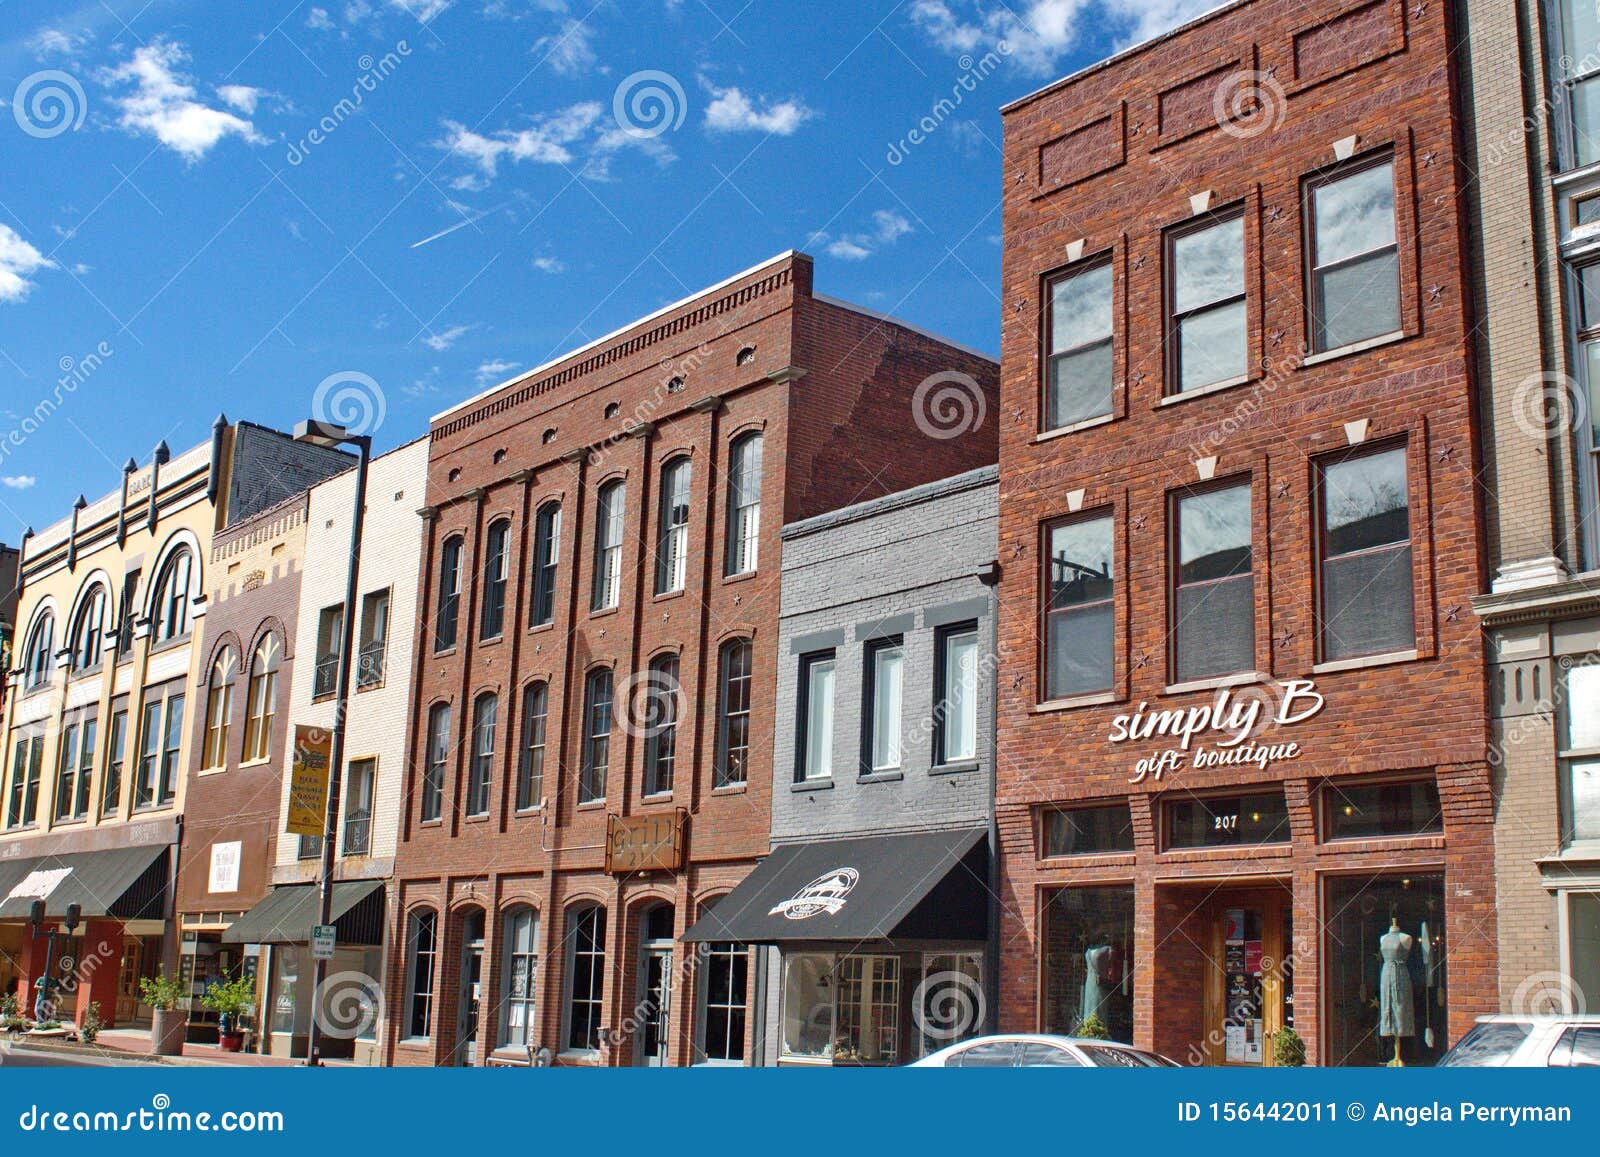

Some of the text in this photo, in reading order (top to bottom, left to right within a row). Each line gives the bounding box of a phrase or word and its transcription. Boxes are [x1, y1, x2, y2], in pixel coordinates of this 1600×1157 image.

[1108, 680, 1324, 750] simply B
[1128, 741, 1301, 783] gift boutique
[614, 815, 672, 857] grill
[1214, 815, 1238, 829] 207
